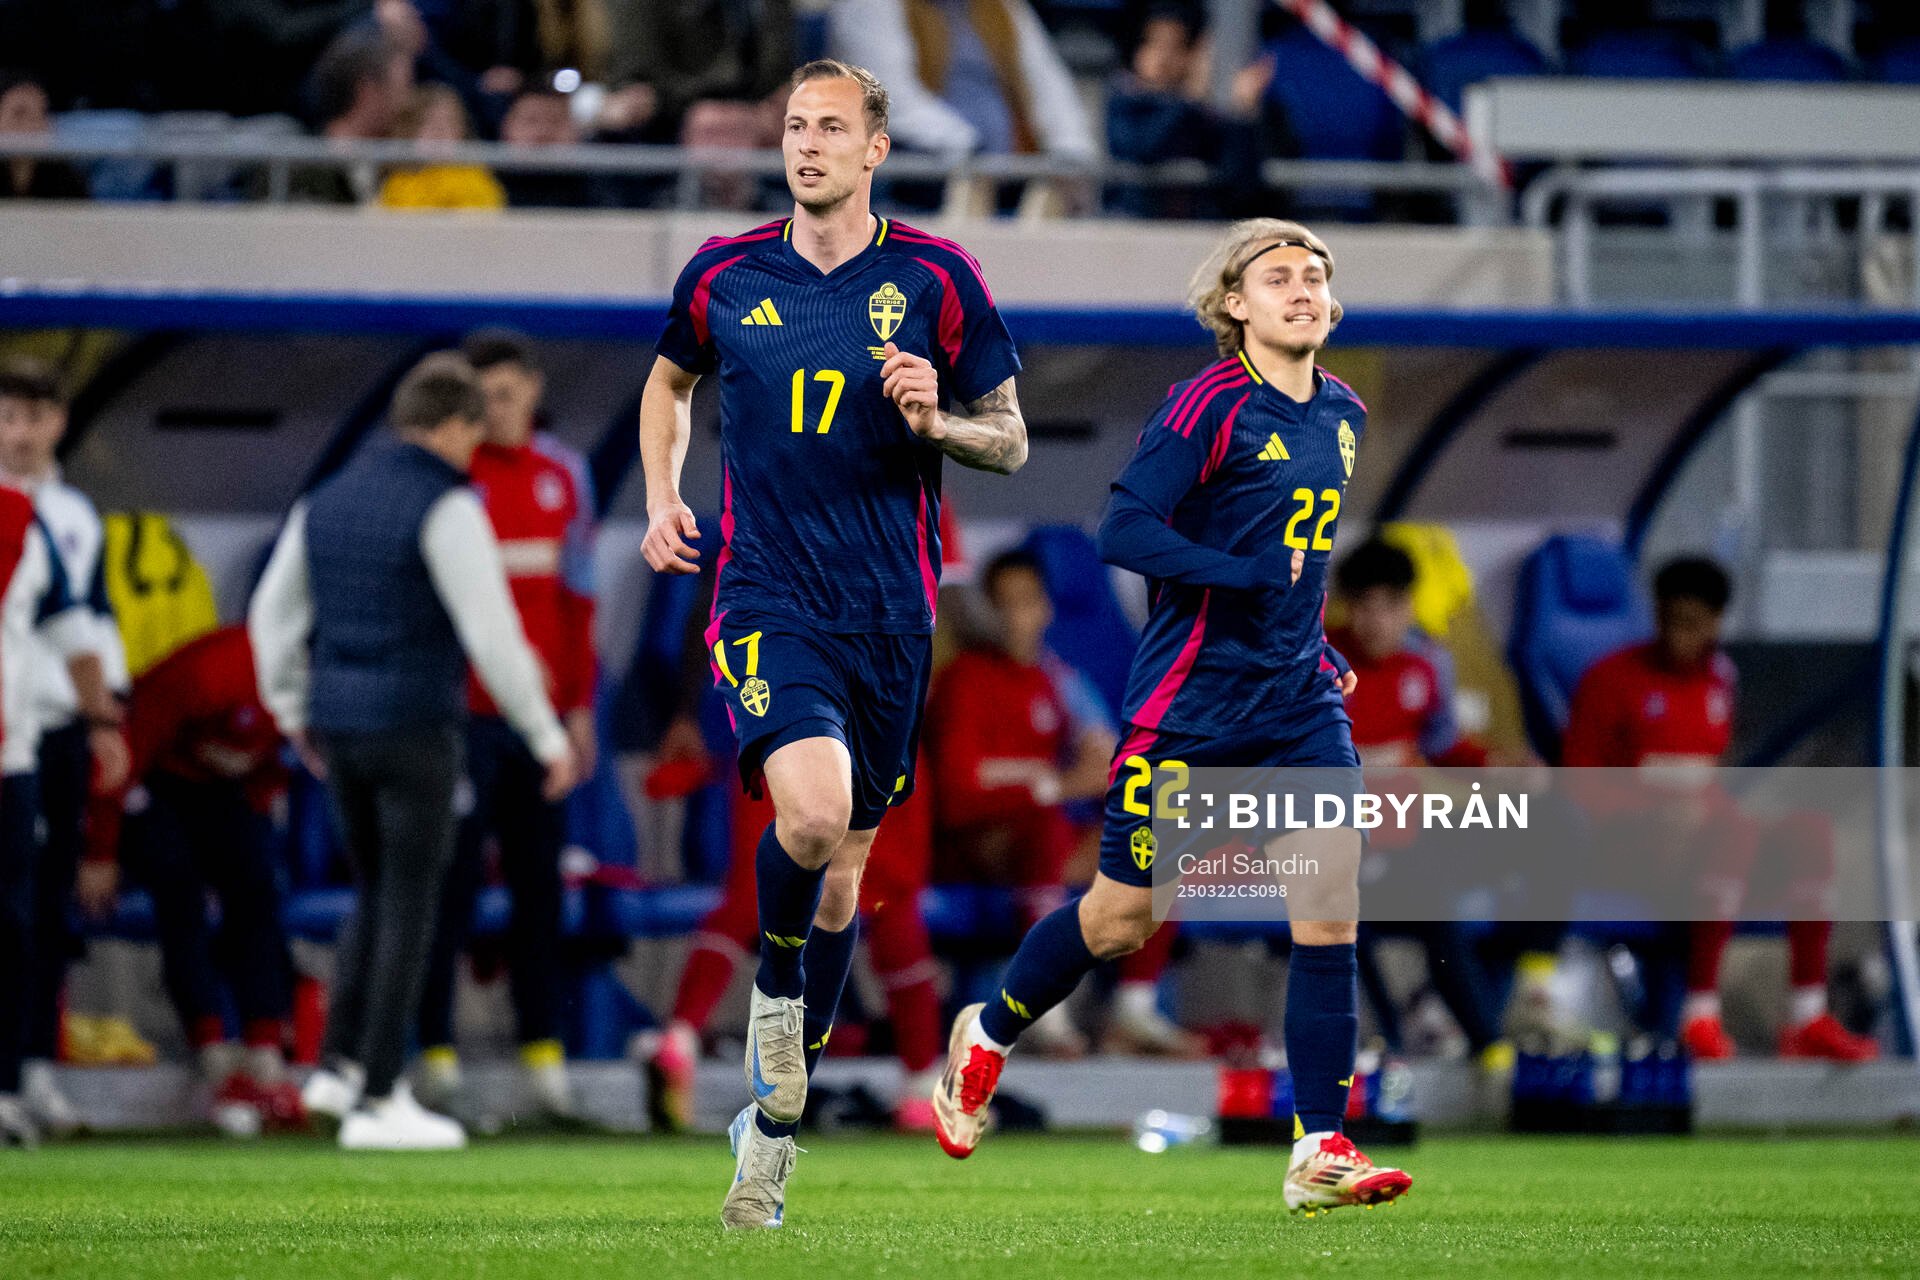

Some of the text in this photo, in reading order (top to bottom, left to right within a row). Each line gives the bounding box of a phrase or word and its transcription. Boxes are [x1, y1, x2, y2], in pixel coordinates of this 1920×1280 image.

[791, 368, 845, 434] 17
[1283, 487, 1341, 551] 22
[713, 630, 762, 688] 17
[1123, 755, 1189, 819] 22
